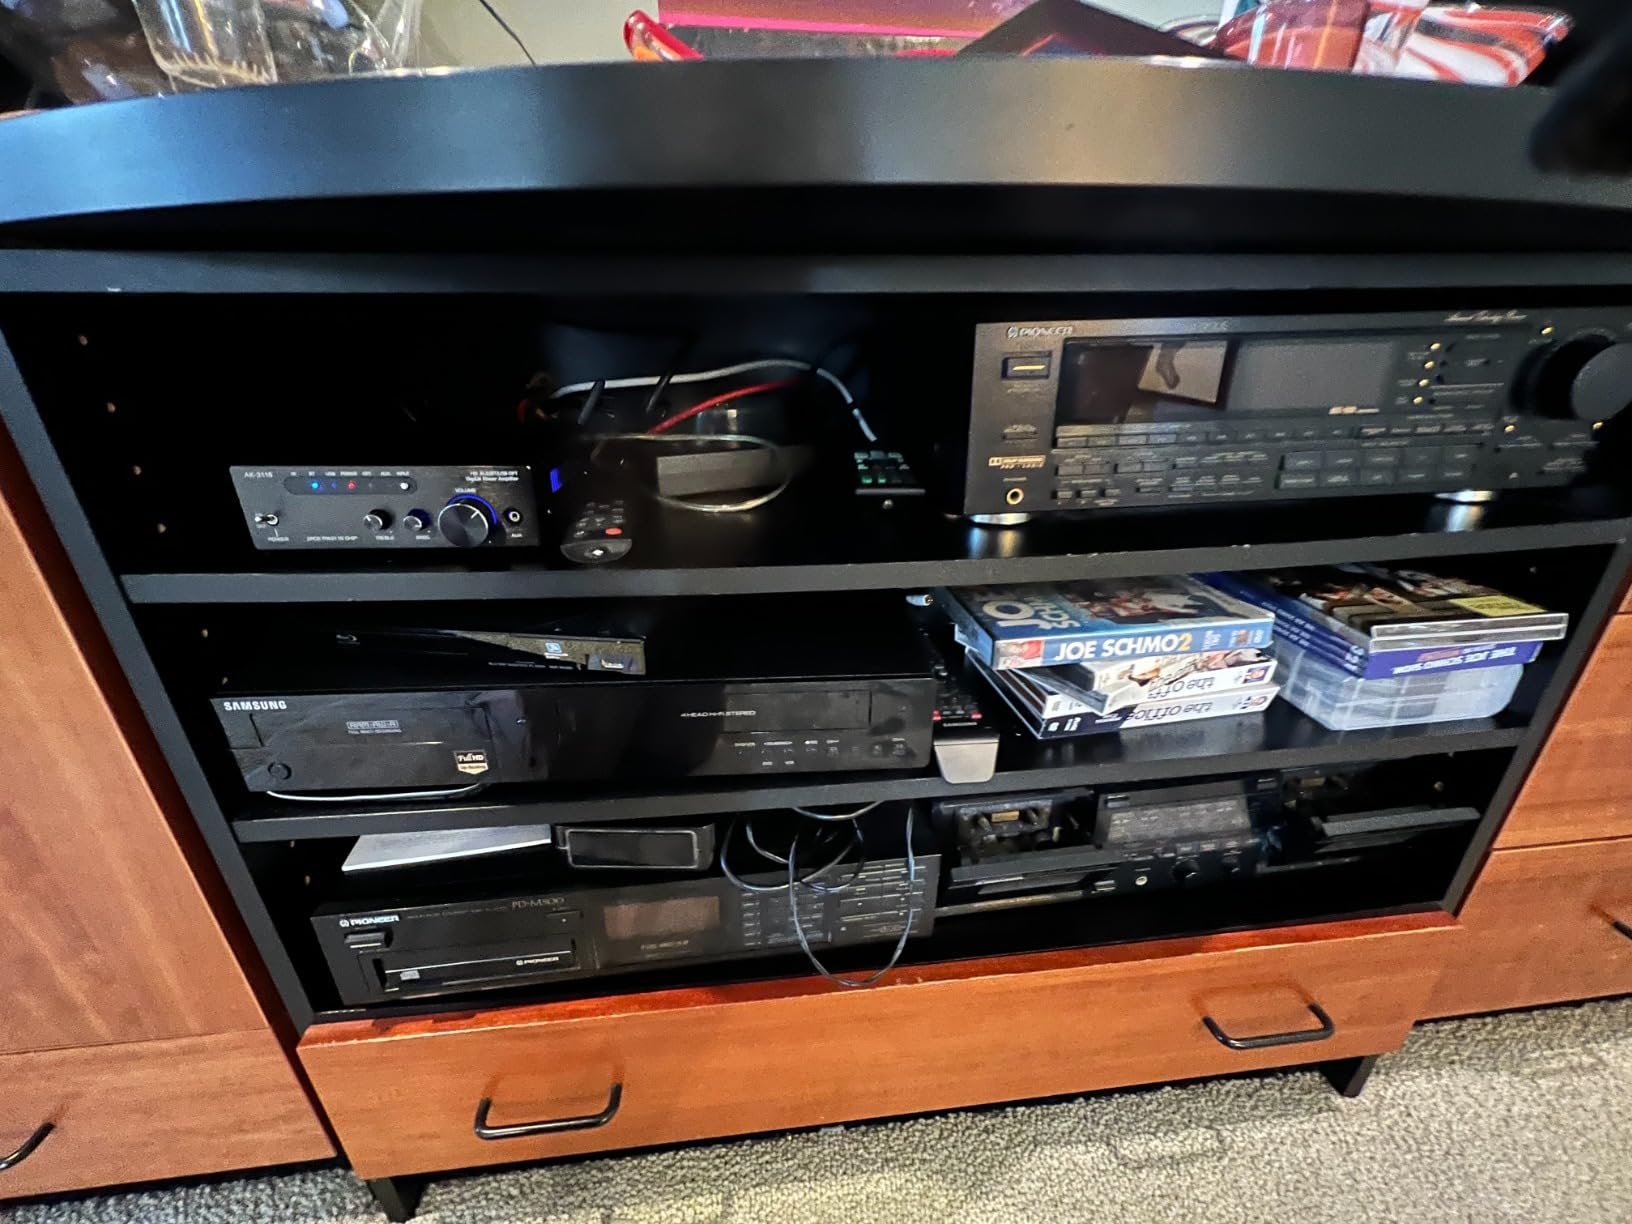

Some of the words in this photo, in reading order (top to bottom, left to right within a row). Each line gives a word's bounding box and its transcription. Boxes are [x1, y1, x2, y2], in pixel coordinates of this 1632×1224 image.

[1054, 640, 1097, 661] JOE
[1185, 676, 1215, 691] the
[223, 699, 288, 712] SAMSUNG
[1182, 701, 1214, 714] the
[350, 914, 400, 926] PIONEER
